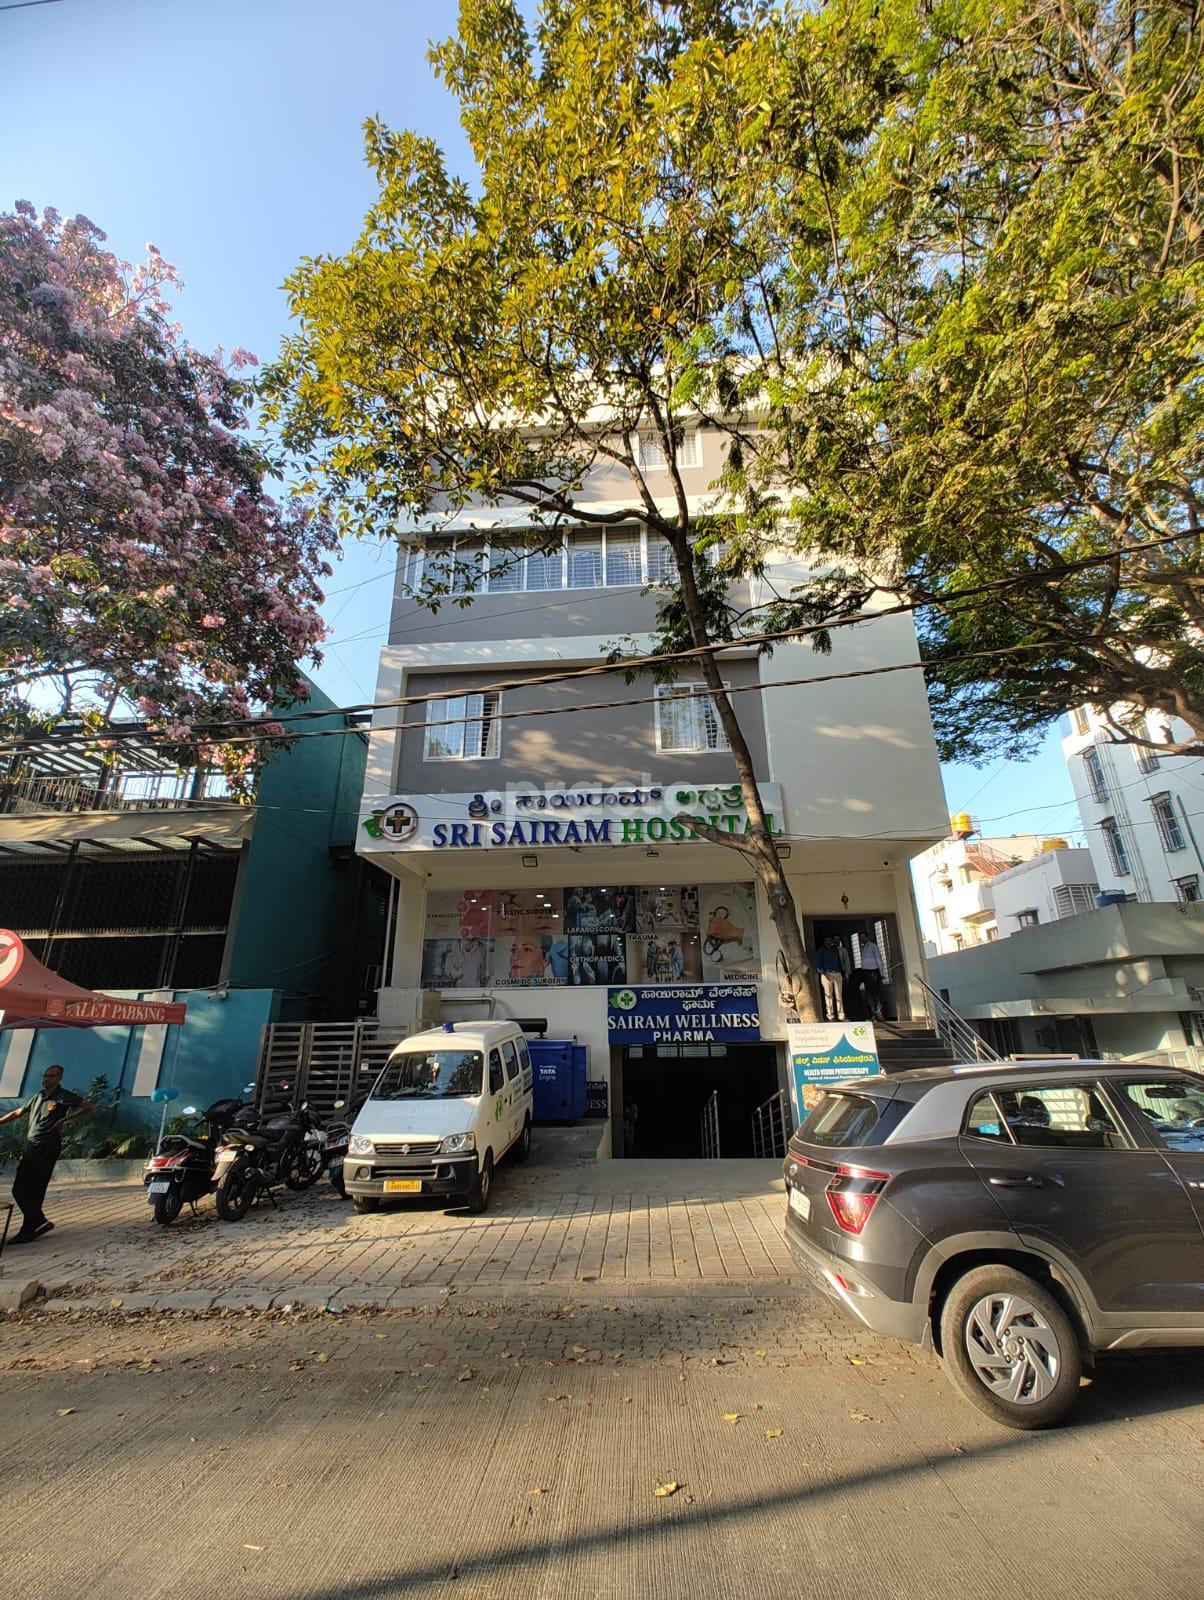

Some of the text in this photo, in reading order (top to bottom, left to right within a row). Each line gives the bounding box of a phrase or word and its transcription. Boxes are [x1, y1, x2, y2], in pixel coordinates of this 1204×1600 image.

[432, 823, 481, 847] SRI
[491, 819, 612, 845] SAIRAM
[567, 926, 619, 934] LAPAROSCOPY
[569, 955, 625, 963] ORTHOPAEDICS
[641, 988, 704, 999] ಸಾಯಿರಾಮ್
[112, 1004, 165, 1021] PARKING
[608, 1013, 760, 1030] SAIRAM WELLNESS
[653, 1031, 714, 1042] PHARMA
